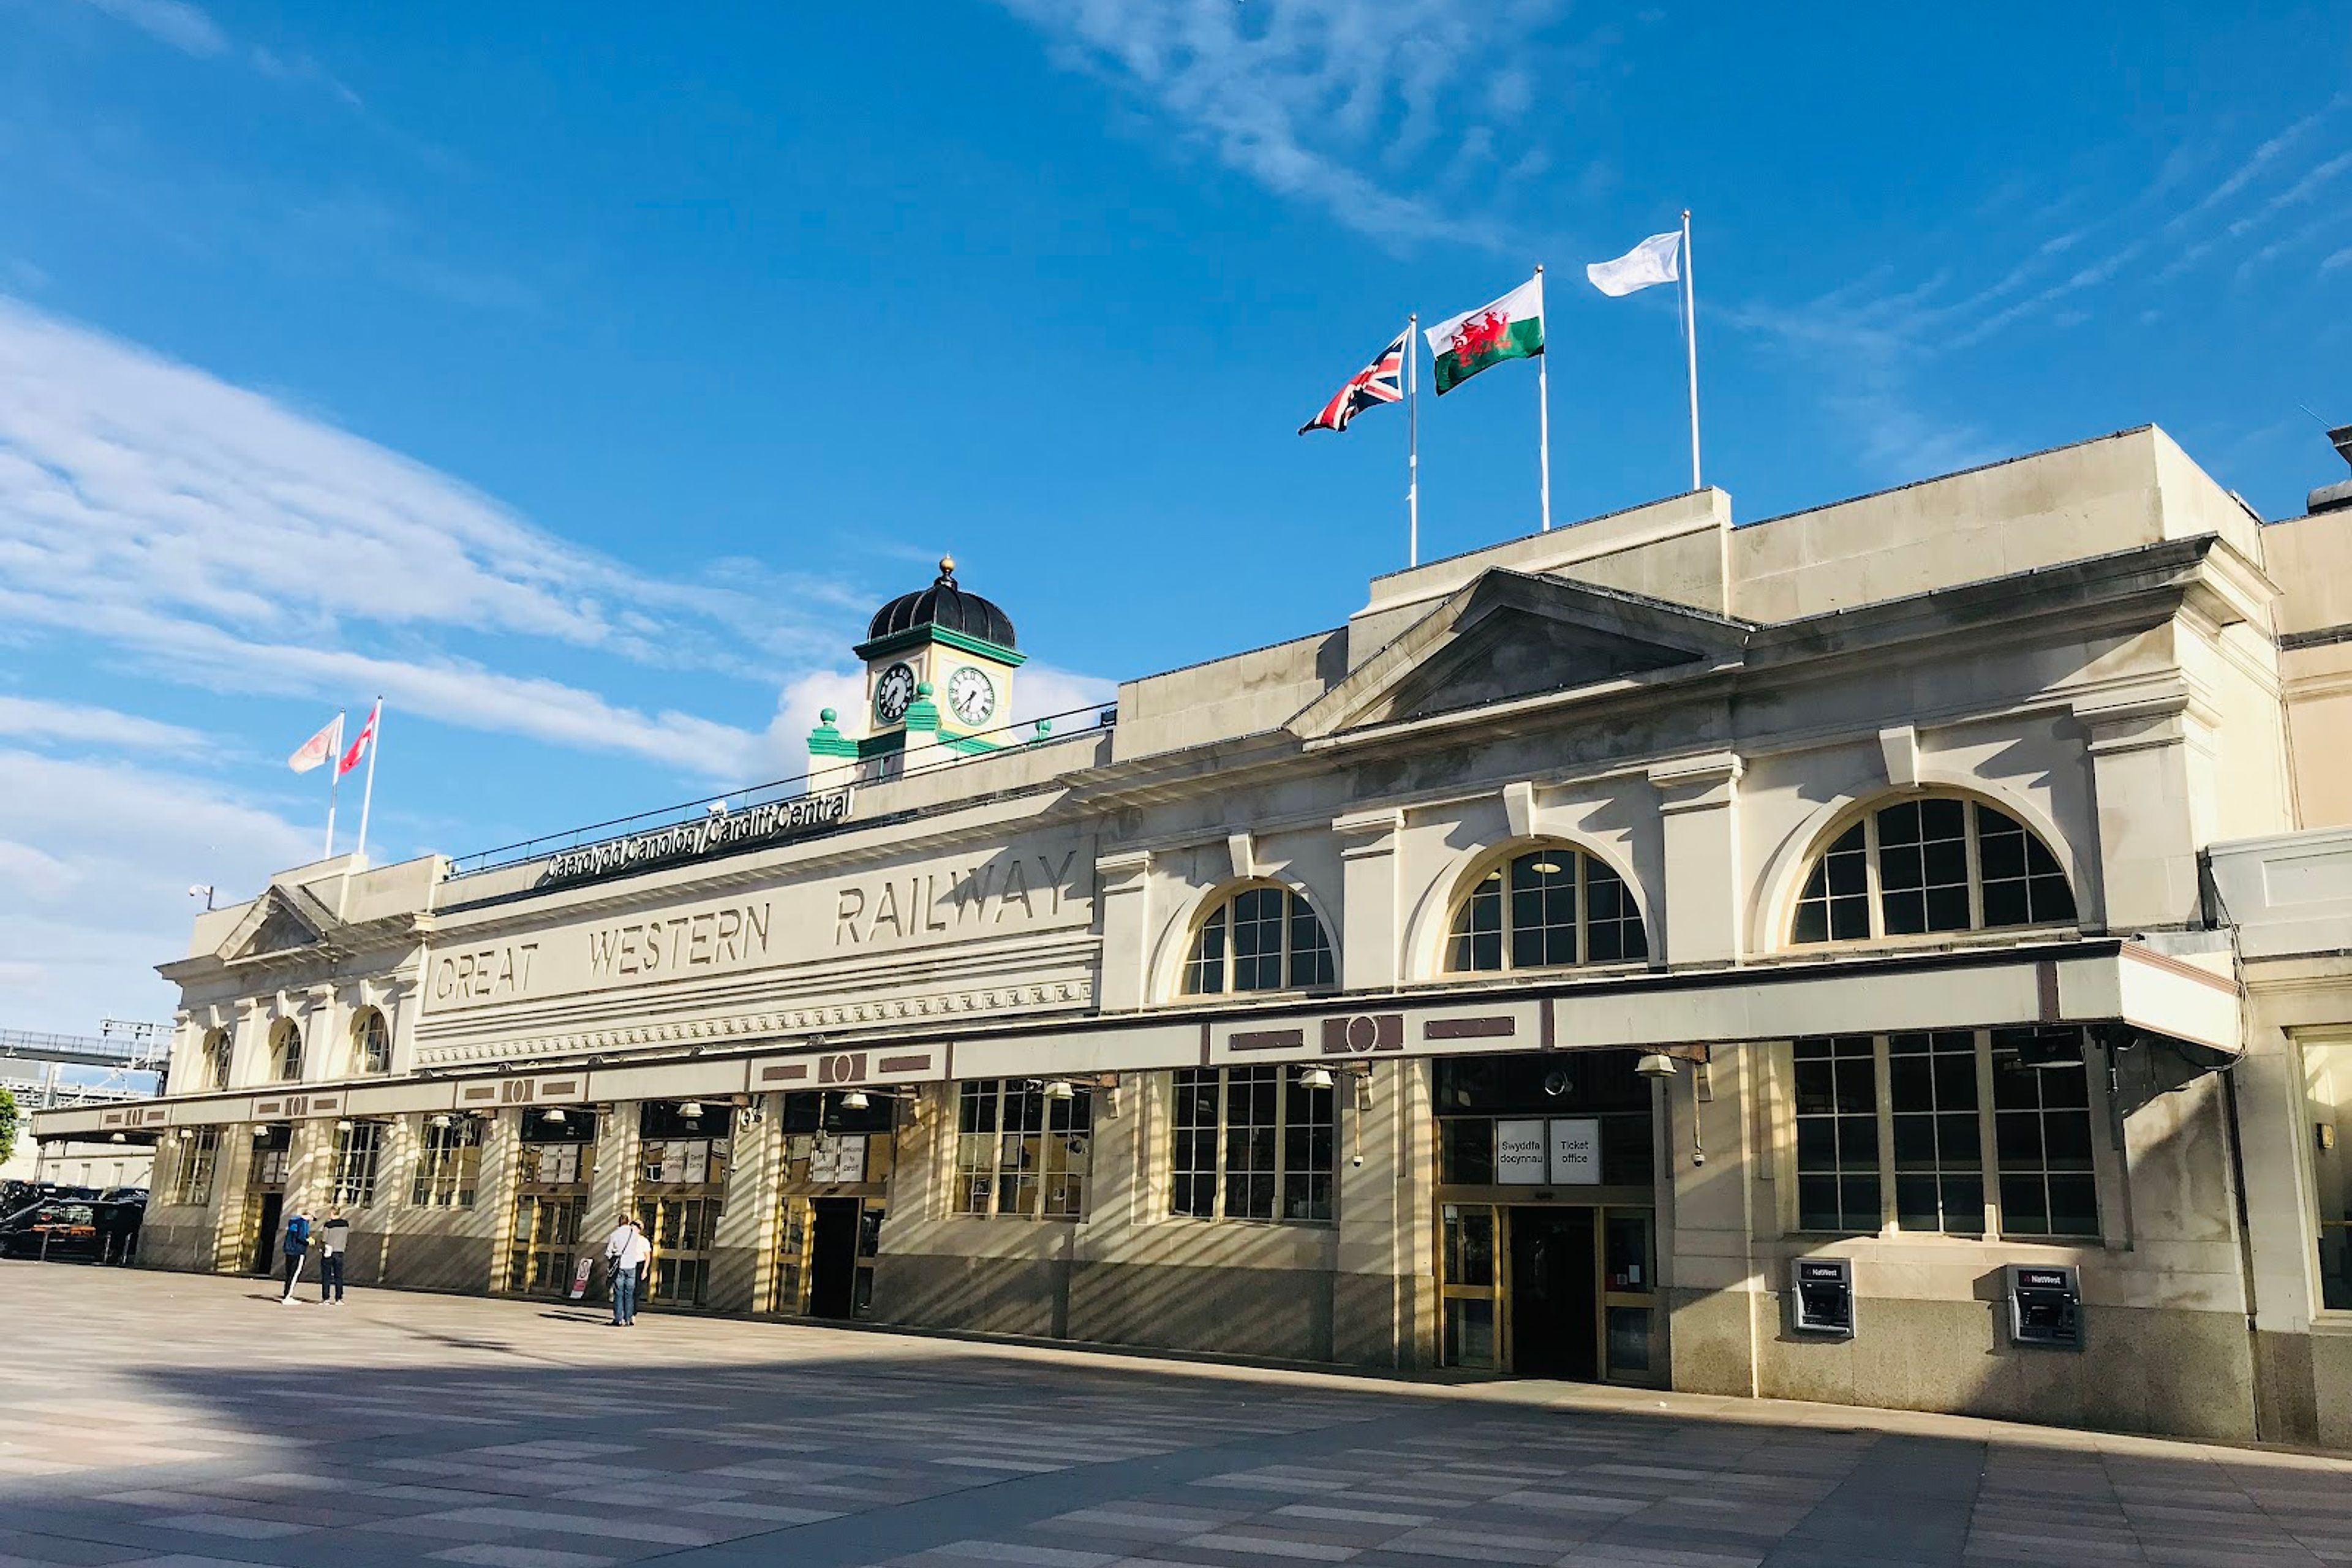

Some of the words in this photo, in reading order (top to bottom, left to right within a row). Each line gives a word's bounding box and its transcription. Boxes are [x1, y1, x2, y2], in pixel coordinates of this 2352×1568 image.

[548, 840, 629, 878] Caerdydd
[777, 786, 854, 827] Central
[436, 943, 539, 1001] GREAT
[589, 903, 771, 979] WESTERN
[834, 850, 1077, 946] RAILWAY
[1561, 1140, 1589, 1150] Ticket
[1562, 1153, 1588, 1163] office
[2032, 1275, 2060, 1284] NatWest
